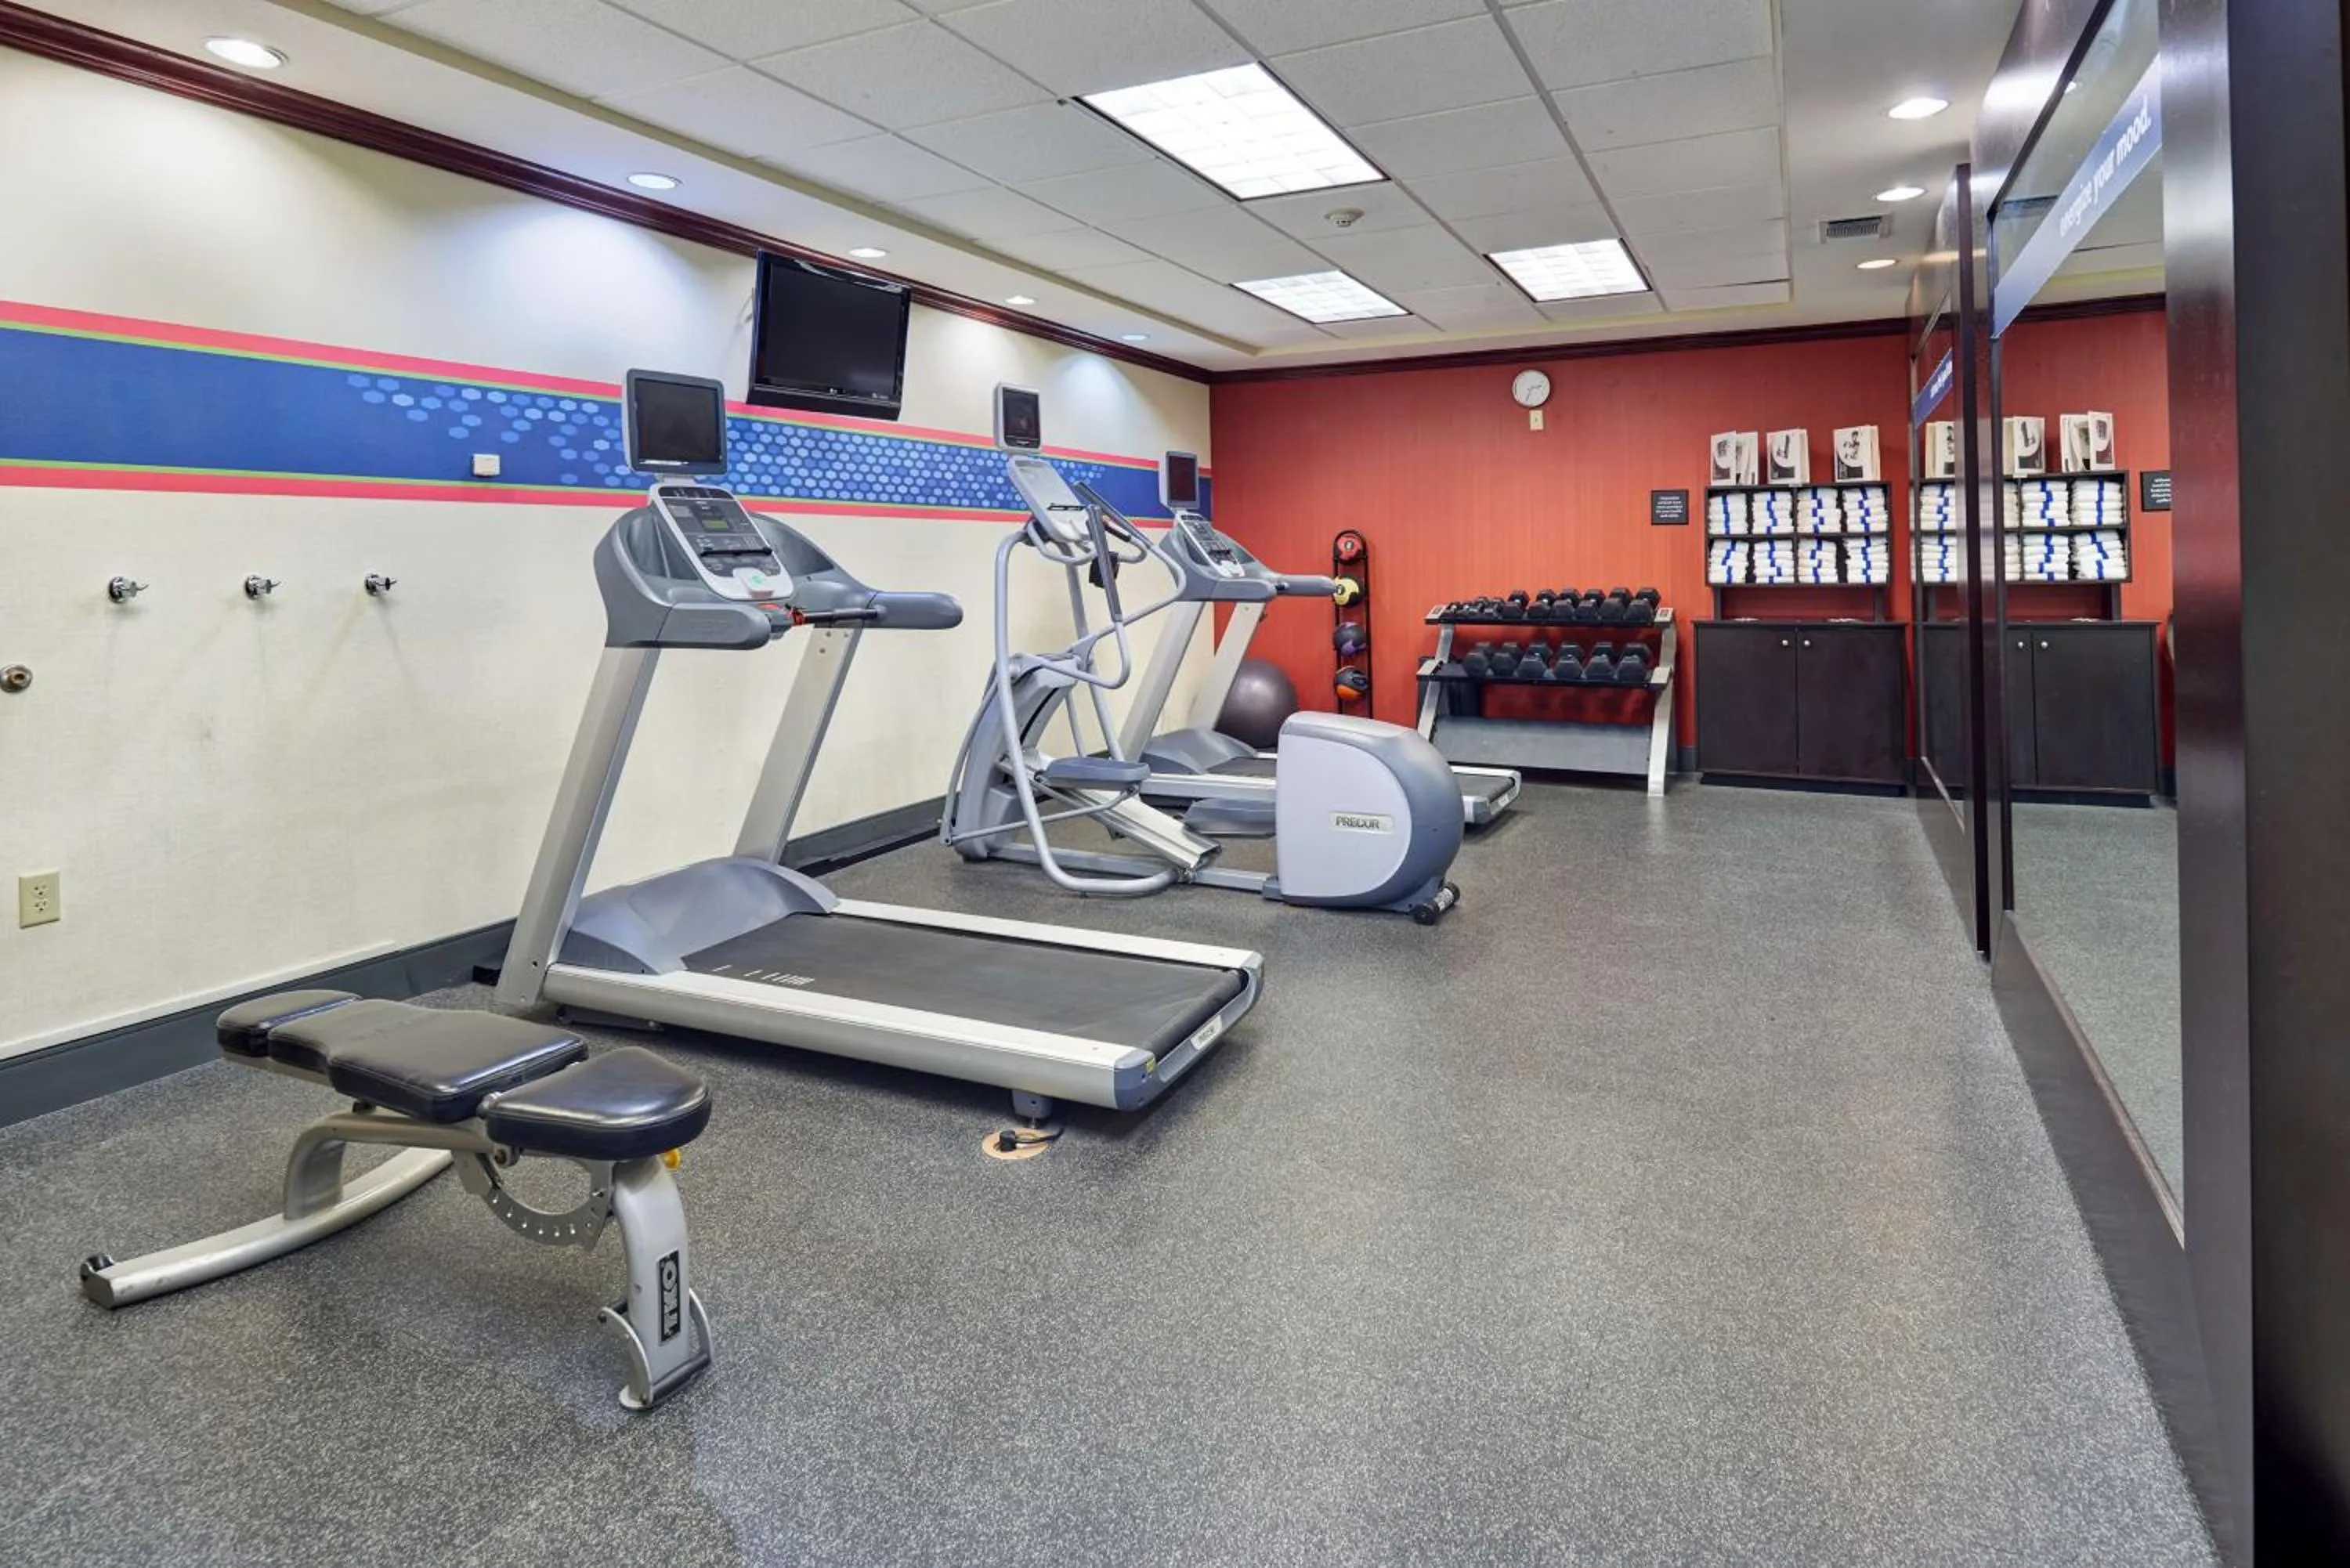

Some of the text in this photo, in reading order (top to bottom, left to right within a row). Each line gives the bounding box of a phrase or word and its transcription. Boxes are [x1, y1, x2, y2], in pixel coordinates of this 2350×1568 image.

[2093, 147, 2115, 204] your
[2117, 95, 2151, 165] mood.
[1336, 815, 1379, 829] PRECOR
